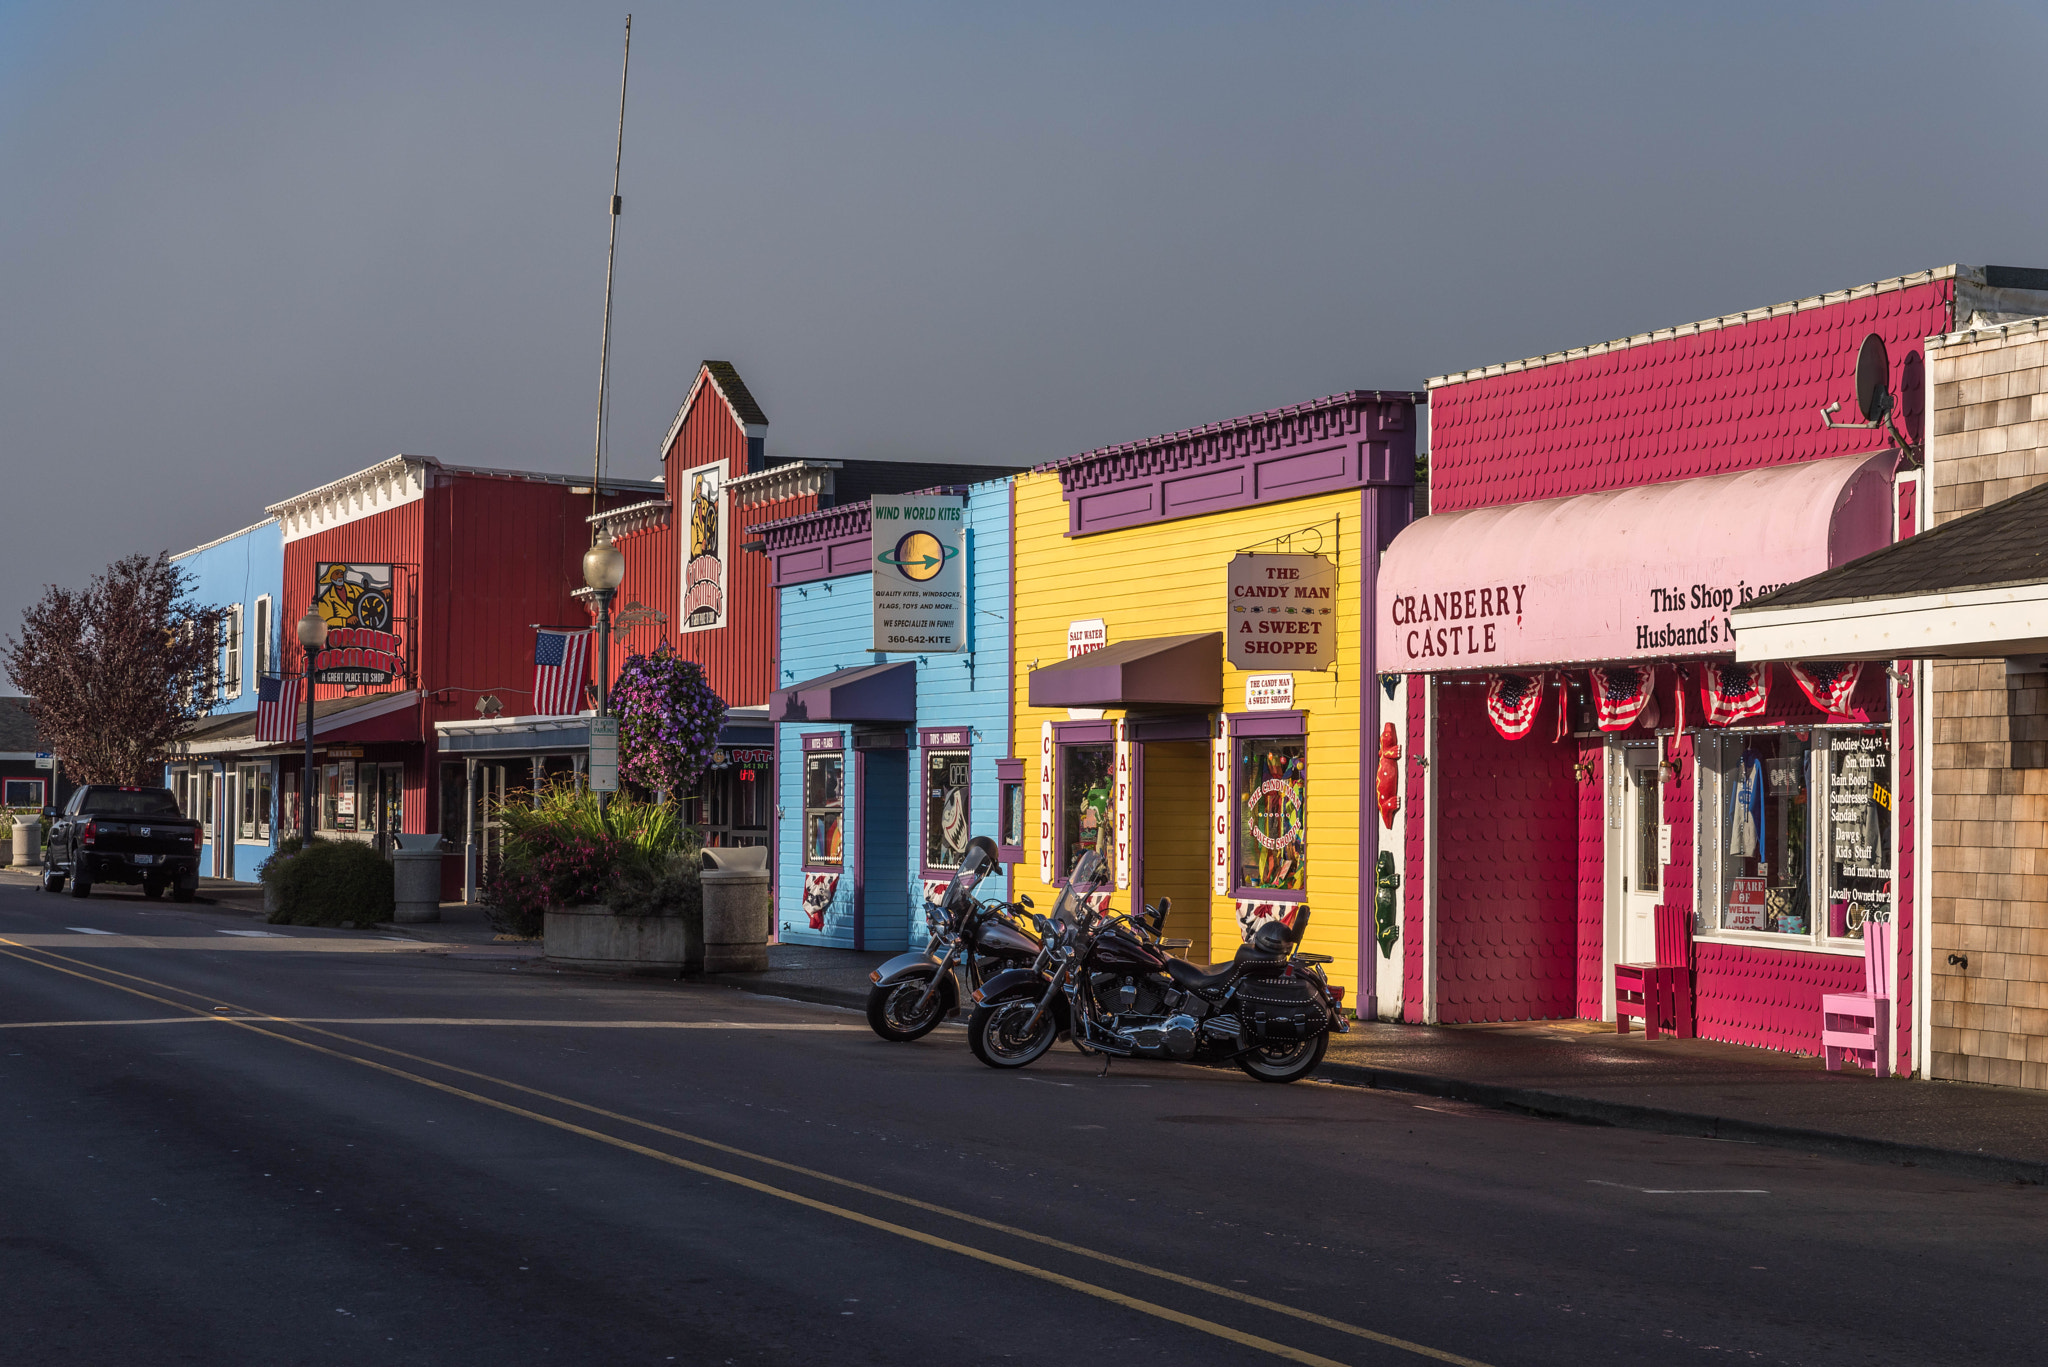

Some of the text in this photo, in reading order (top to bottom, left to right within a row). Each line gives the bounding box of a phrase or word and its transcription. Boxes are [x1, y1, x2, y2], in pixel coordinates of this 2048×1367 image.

[875, 507, 961, 520] WIND WORLD KITES
[1266, 568, 1300, 580] THE
[1234, 586, 1330, 599] CANDY MAN
[1651, 586, 1686, 613] This
[1691, 584, 1734, 612] Shop
[1739, 580, 1753, 605] is
[1392, 584, 1526, 626] CRANBERRY
[883, 620, 955, 628] WE SPECIALIZE IN FUN!!!
[1239, 621, 1322, 635] A SWEET
[887, 635, 952, 644] 360-642-KITE
[1069, 629, 1103, 641] SALT WATER
[1636, 618, 1718, 649] Husband's
[327, 627, 402, 655] ORMIN'
[1244, 641, 1318, 655] SHOPPE
[1406, 623, 1497, 659] CASTLE
[321, 672, 385, 683] A GREAT PLACE TO SHOP
[1250, 678, 1291, 688] THE CANDY MAN
[1252, 696, 1270, 704] SWEET
[1270, 695, 1292, 704] SHOPPE
[1845, 754, 1886, 768] Sm thru 5X
[951, 765, 970, 785] OPEN
[1831, 773, 1868, 786] Rain Boots
[1119, 723, 1127, 861] TAFFY
[1217, 720, 1226, 866] FUDGE
[1247, 778, 1302, 811] THE CANDY MAN
[1831, 790, 1868, 804] Sundresses
[1042, 737, 1051, 867] CANDY
[1831, 808, 1857, 822] Sandals
[1253, 825, 1275, 850] SWEET
[1275, 817, 1302, 850] SHOPPE
[1835, 828, 1860, 843] Dawgs
[1854, 845, 1873, 858] Stuff
[1843, 864, 1856, 876] and
[1857, 864, 1877, 878] much
[1729, 881, 1764, 892] EWARE
[1829, 887, 1851, 902] Locally
[1852, 888, 1875, 902] Owned
[1875, 889, 1886, 902] for
[1732, 916, 1756, 925] JUST
